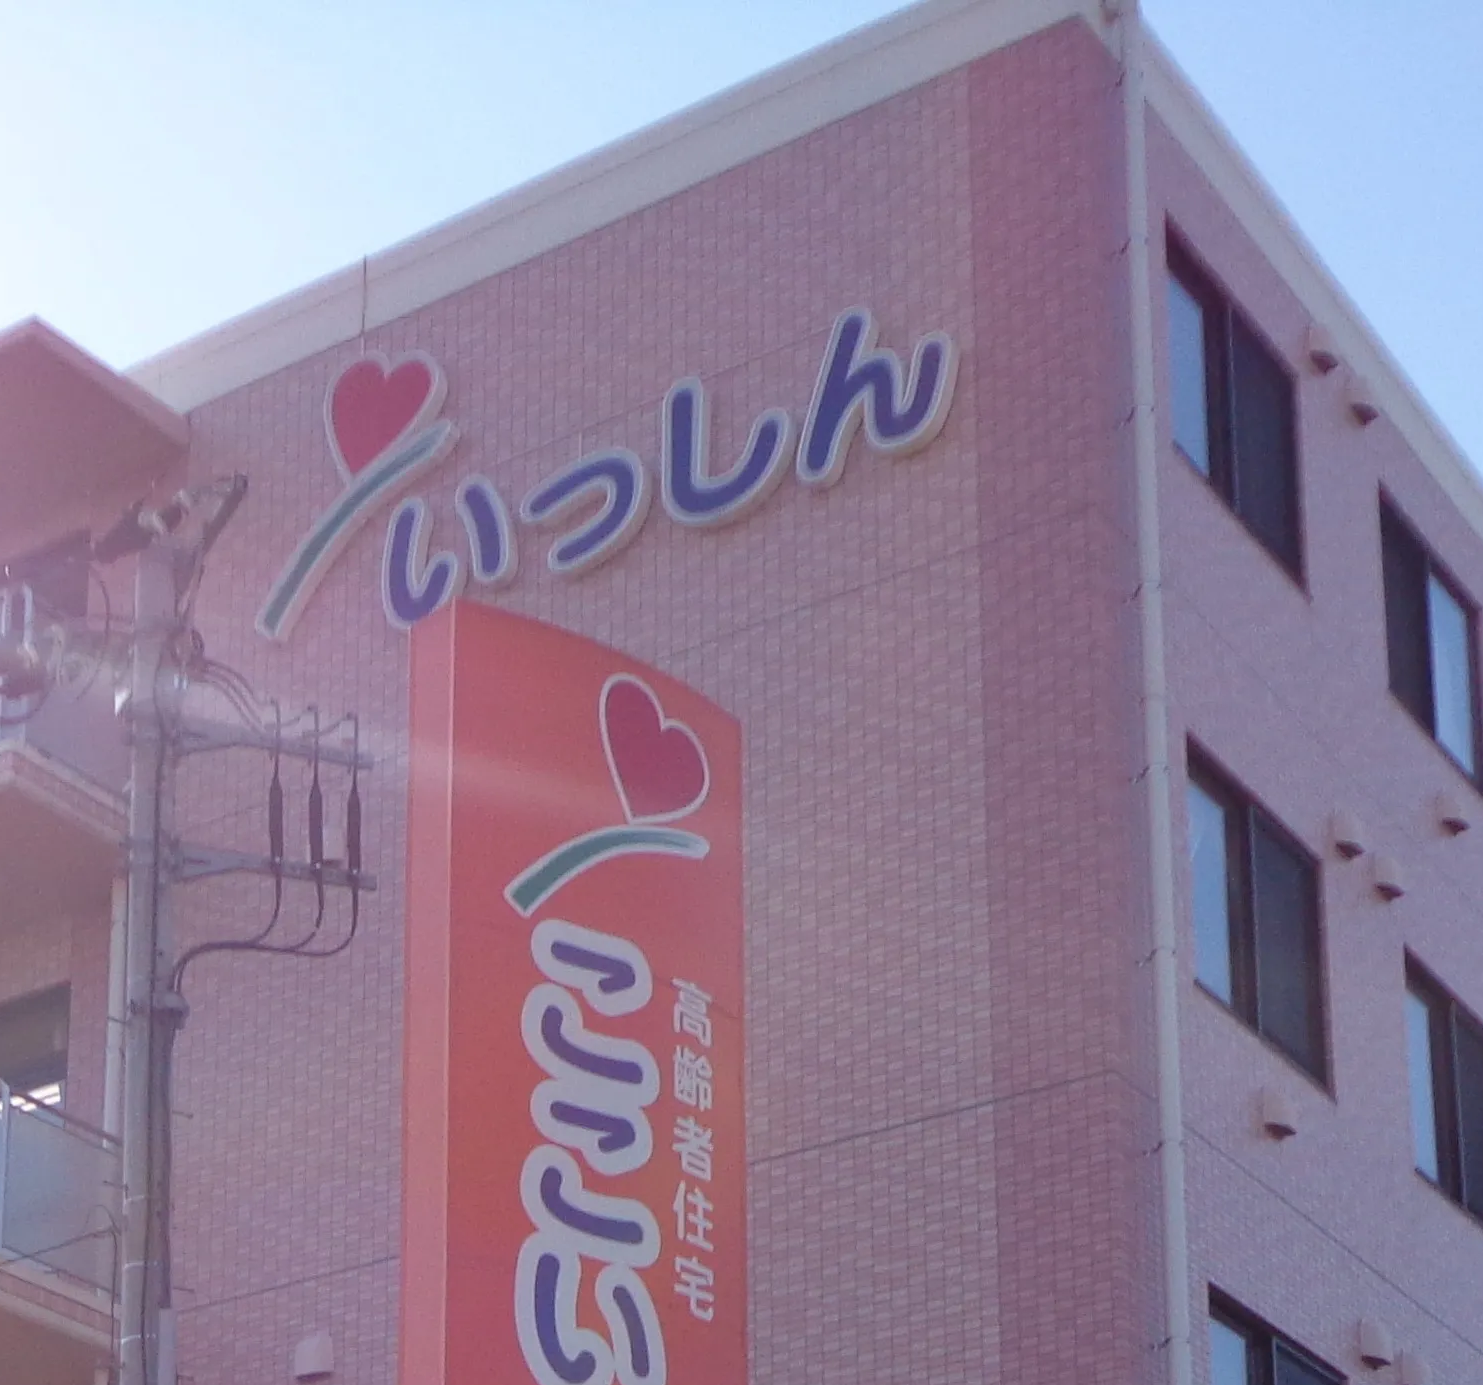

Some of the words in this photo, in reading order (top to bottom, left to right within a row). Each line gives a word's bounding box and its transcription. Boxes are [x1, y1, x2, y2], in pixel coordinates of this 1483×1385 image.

[382, 306, 960, 628] いっしん
[670, 976, 715, 1323] 高齢者住宅
